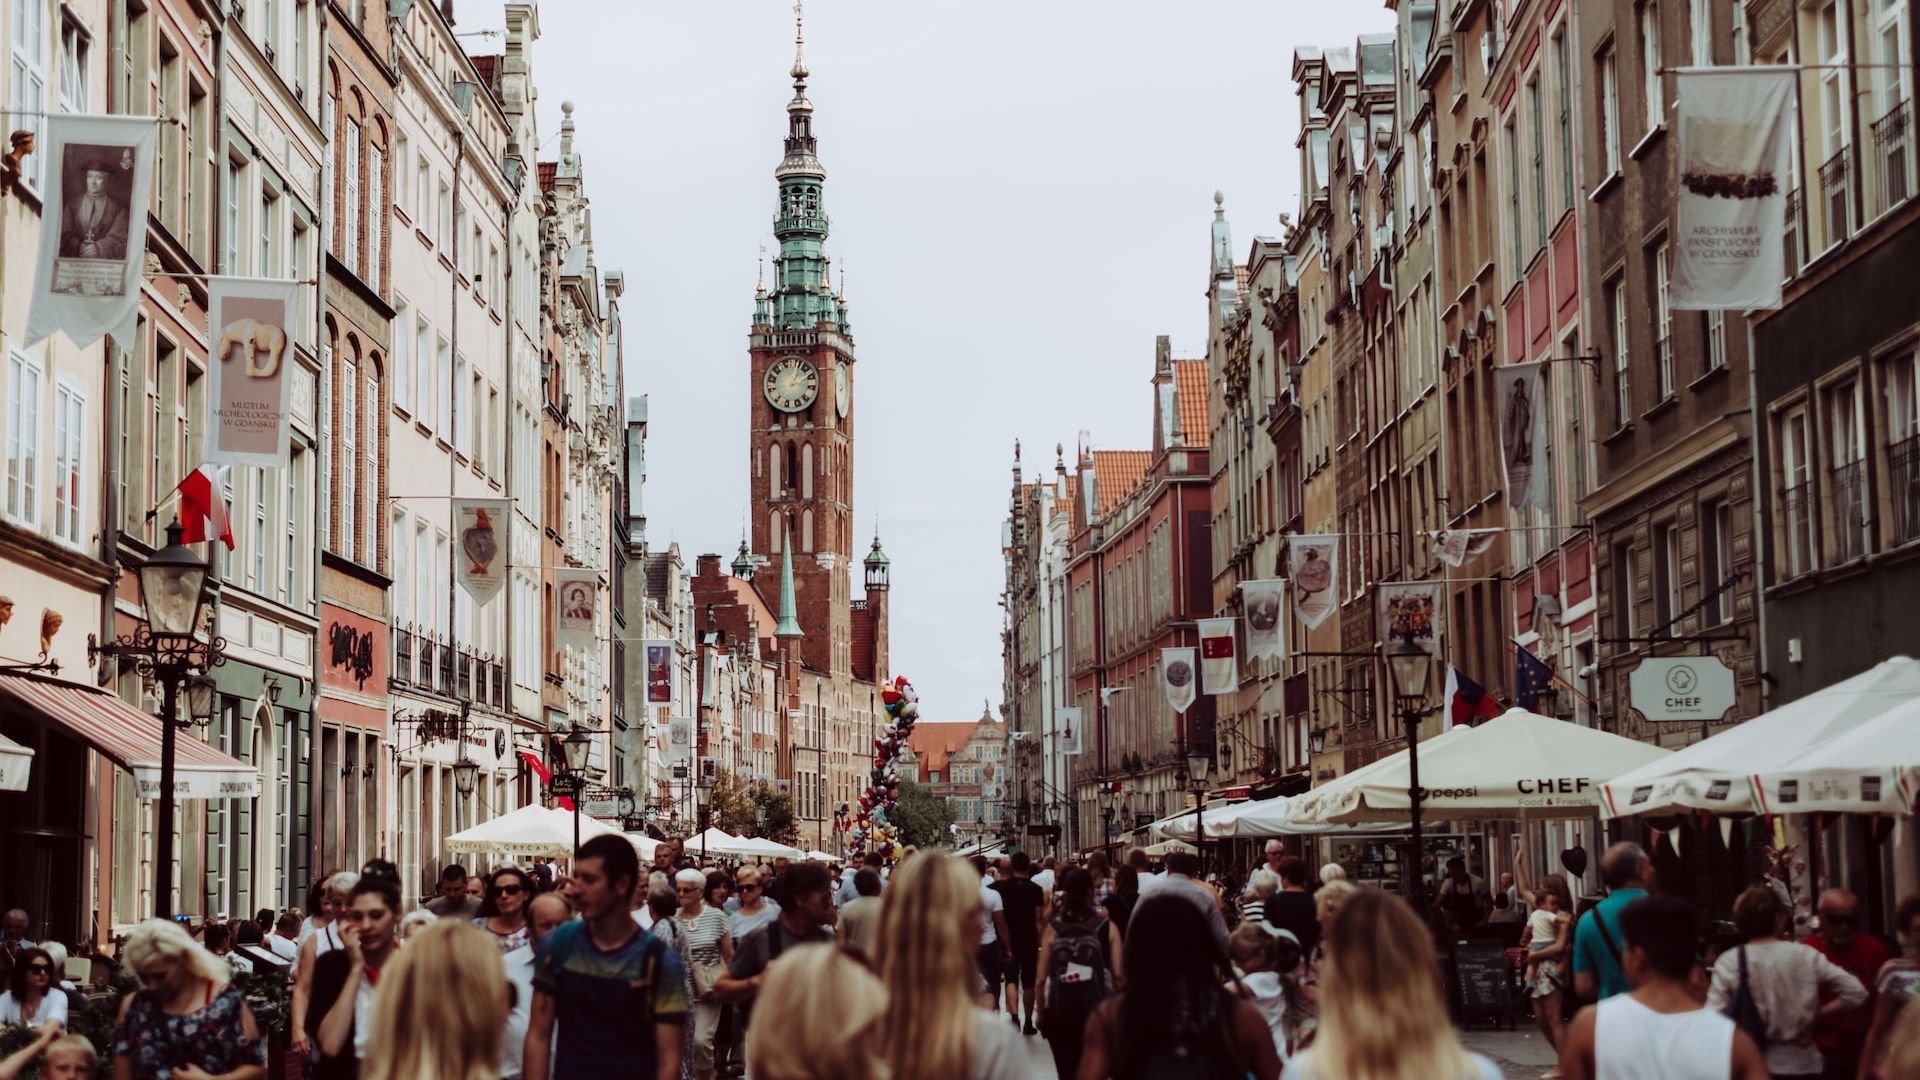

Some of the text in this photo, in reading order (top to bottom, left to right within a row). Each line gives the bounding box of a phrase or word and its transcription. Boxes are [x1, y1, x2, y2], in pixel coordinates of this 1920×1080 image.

[231, 401, 269, 409] MUZEUM
[223, 419, 233, 427] W
[1665, 698, 1702, 708] CHEF
[1517, 777, 1590, 794] CHEF
[1432, 785, 1478, 800] pepsi
[1517, 797, 1591, 806] Food & Friends
